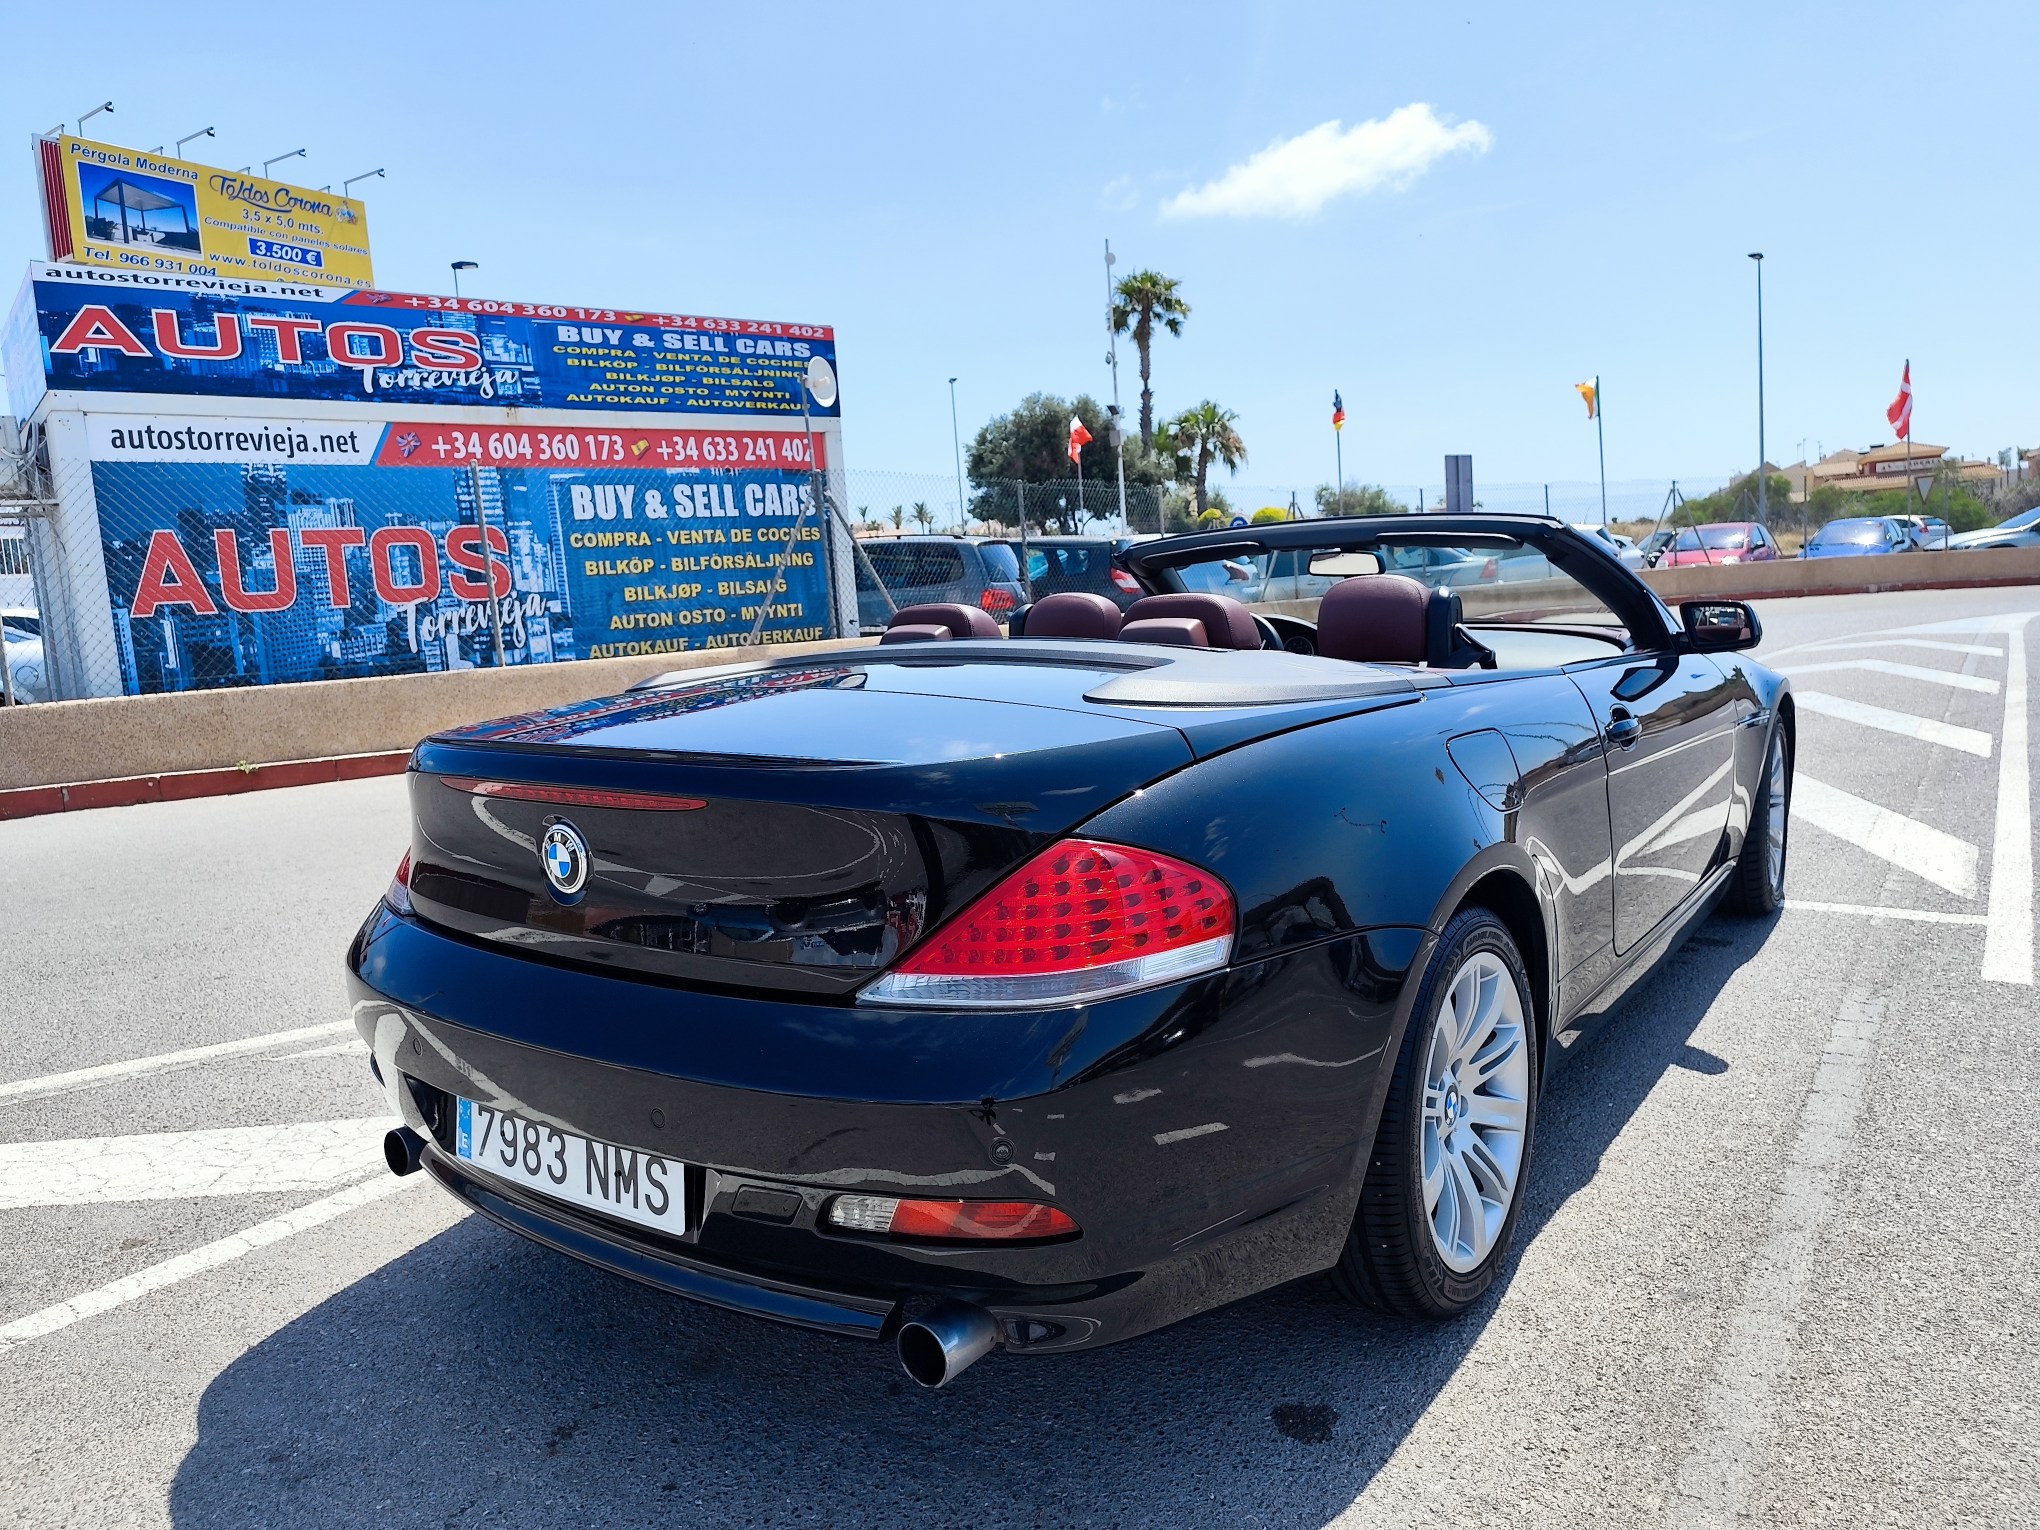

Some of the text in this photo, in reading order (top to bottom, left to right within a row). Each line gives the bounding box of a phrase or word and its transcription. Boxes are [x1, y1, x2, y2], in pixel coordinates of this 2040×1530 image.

[71, 143, 199, 180] Pérgola Moderna
[209, 174, 333, 217] Toldos Corona
[242, 208, 324, 235] 3,5 x 5,0 mts.
[204, 216, 369, 256] Compatible con paneles solares
[82, 246, 217, 277] Tel. 966 931 004
[255, 241, 317, 265] 3.500 €
[45, 268, 324, 299] autostorrevieja.net
[209, 252, 372, 289] www.toldoscorona.es
[404, 297, 617, 322] +34 604 360 173
[50, 304, 483, 372] AUTOS
[652, 315, 825, 339] +34 633 241 402
[557, 325, 811, 358] BUY & SELL CARS
[552, 345, 636, 359] COMPRA
[653, 352, 713, 363] VENTA
[720, 355, 741, 366] DE
[746, 357, 810, 368] COCHES
[567, 357, 638, 370] BILKÖP
[655, 362, 804, 379] BILFÖRSÄLJNING
[353, 364, 519, 399] Torrevieja
[589, 382, 655, 394] AUTON
[661, 386, 709, 396] OSTO
[725, 388, 790, 399] MYYNTI
[605, 371, 686, 384] BILKJØP
[702, 376, 775, 388] BILSALG
[566, 393, 669, 405] AUTOKAUF
[110, 425, 361, 459] autostorrevieja.net
[431, 431, 625, 461] +34 604 360 173
[656, 436, 700, 461] +34
[703, 436, 739, 461] 633
[743, 437, 777, 461] 241
[570, 483, 817, 520] BUY & SELL CARS
[570, 531, 651, 548] COMPRA
[666, 529, 726, 545] VENTA
[730, 528, 752, 543] DE
[130, 525, 512, 618] AUTOS
[585, 558, 655, 576] BILKÖP
[624, 583, 702, 602] BILKJØP
[404, 590, 547, 654] Torreveja
[610, 612, 673, 630] AUTON
[678, 608, 726, 625] OSTO
[741, 603, 803, 621] MYYNTI
[589, 637, 689, 660] AUTOKAUF
[461, 1132, 469, 1149] E
[477, 1104, 669, 1216] 7983 NMS
